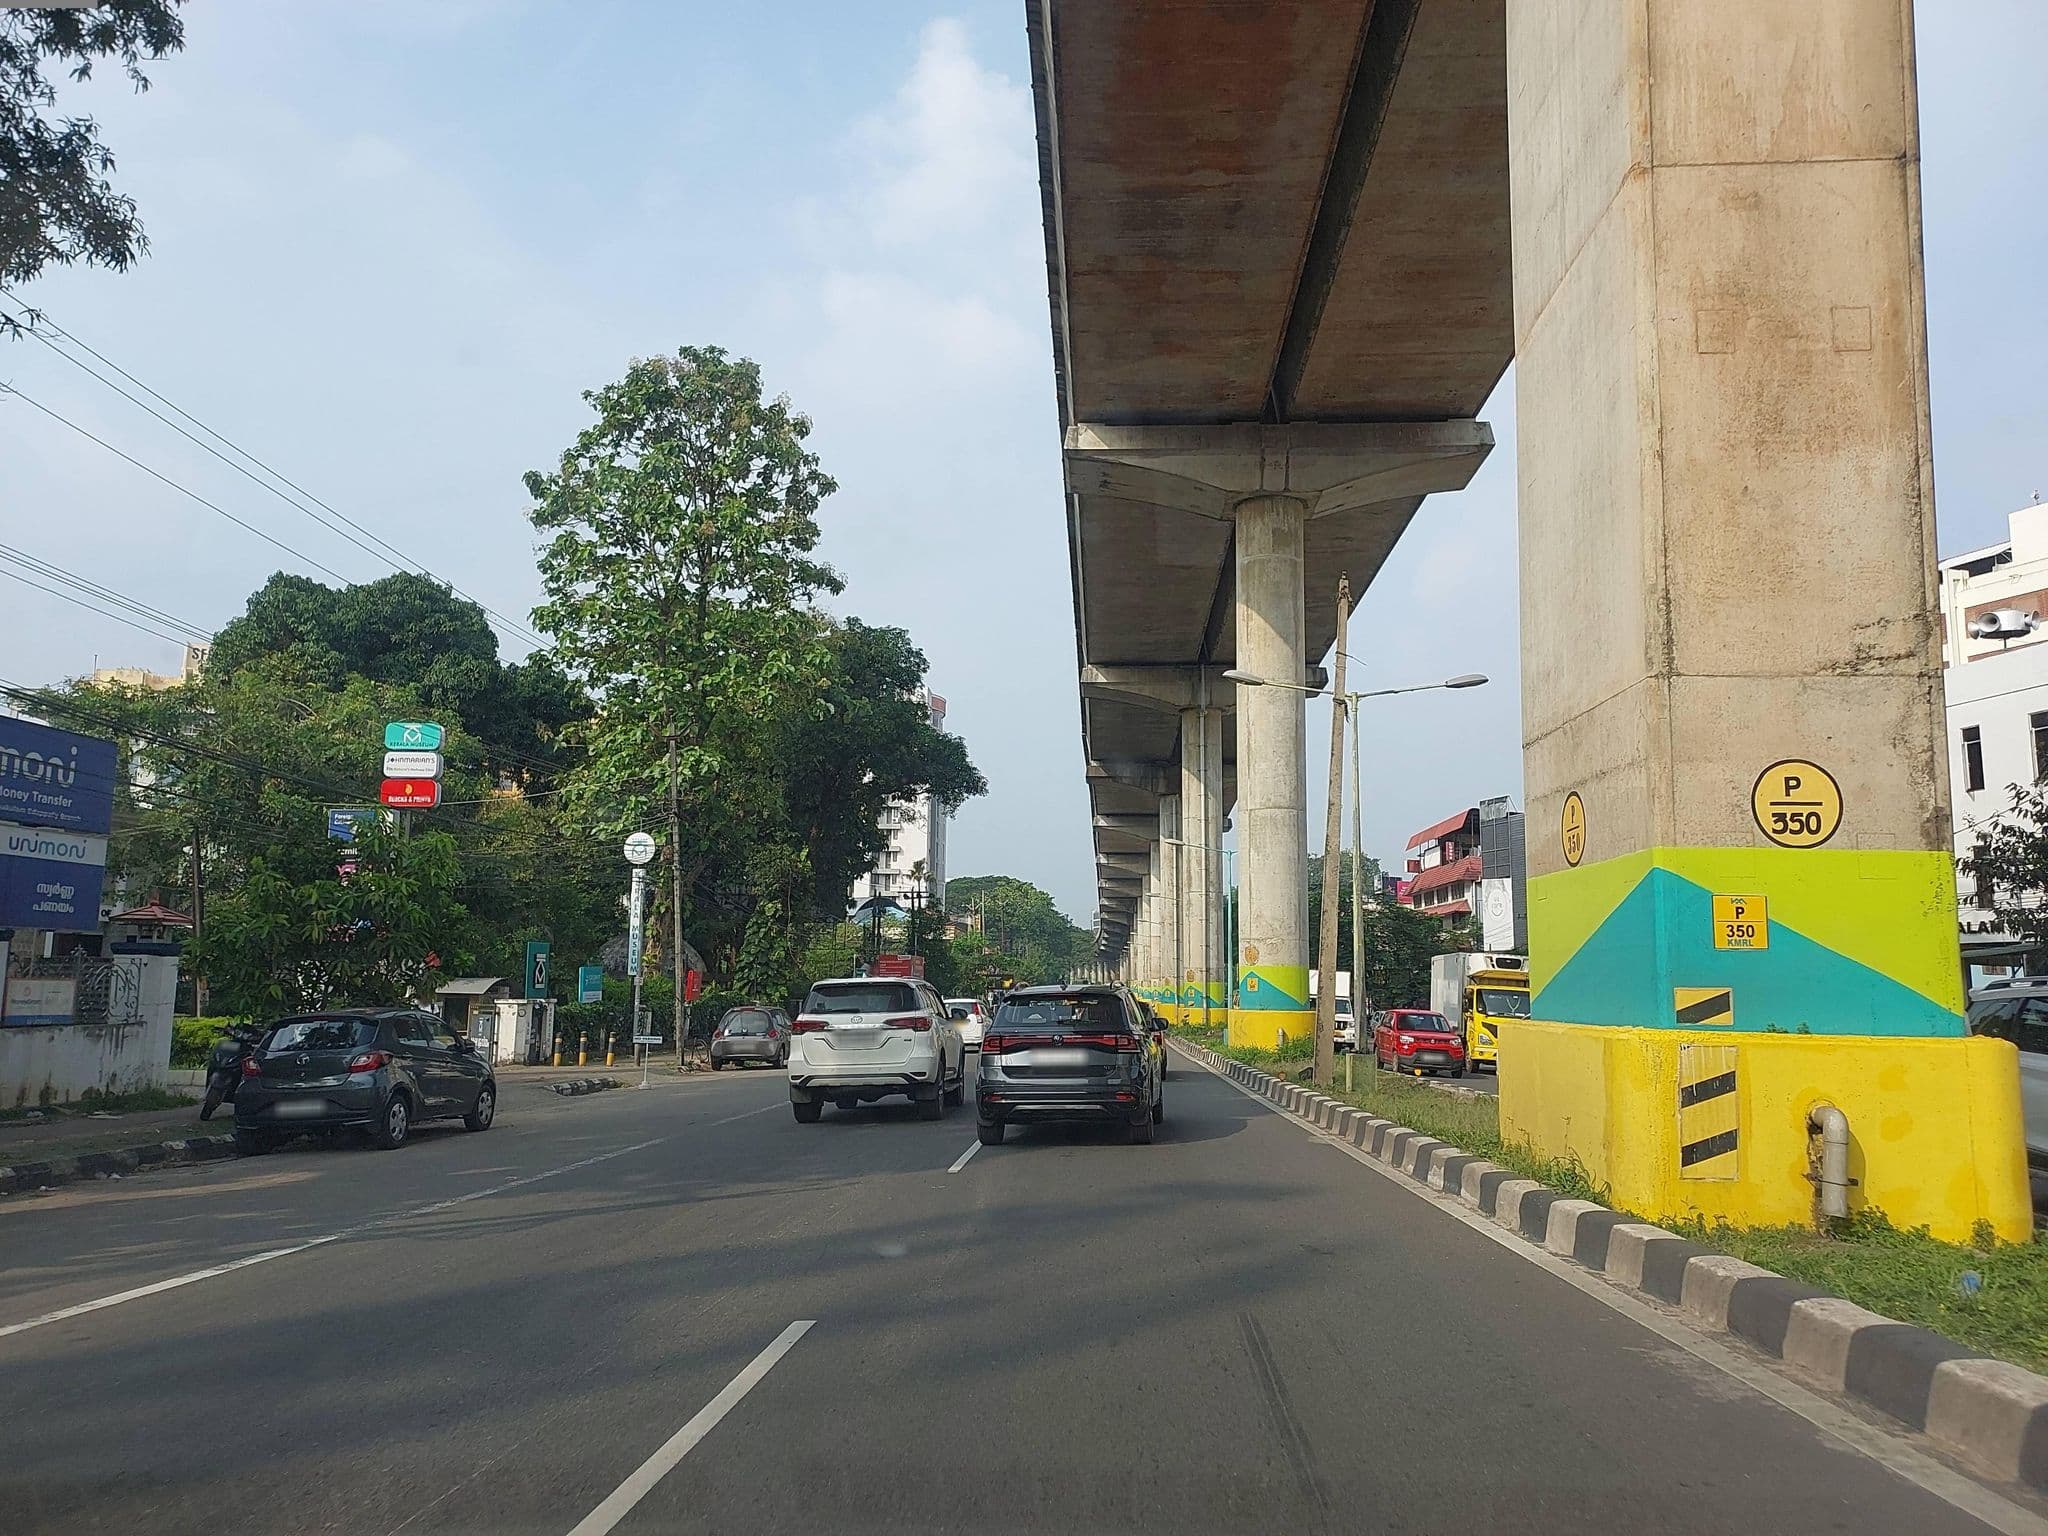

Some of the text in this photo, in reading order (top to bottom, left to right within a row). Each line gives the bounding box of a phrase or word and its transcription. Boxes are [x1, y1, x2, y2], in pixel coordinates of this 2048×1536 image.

[1784, 776, 1801, 797] P
[32, 790, 73, 808] Transfer
[1771, 811, 1823, 836] 350
[9, 832, 87, 859] unimoni
[32, 901, 74, 913] പണയം
[1735, 906, 1745, 920] P
[1726, 924, 1755, 938] 350
[1727, 938, 1754, 947] KMRL
